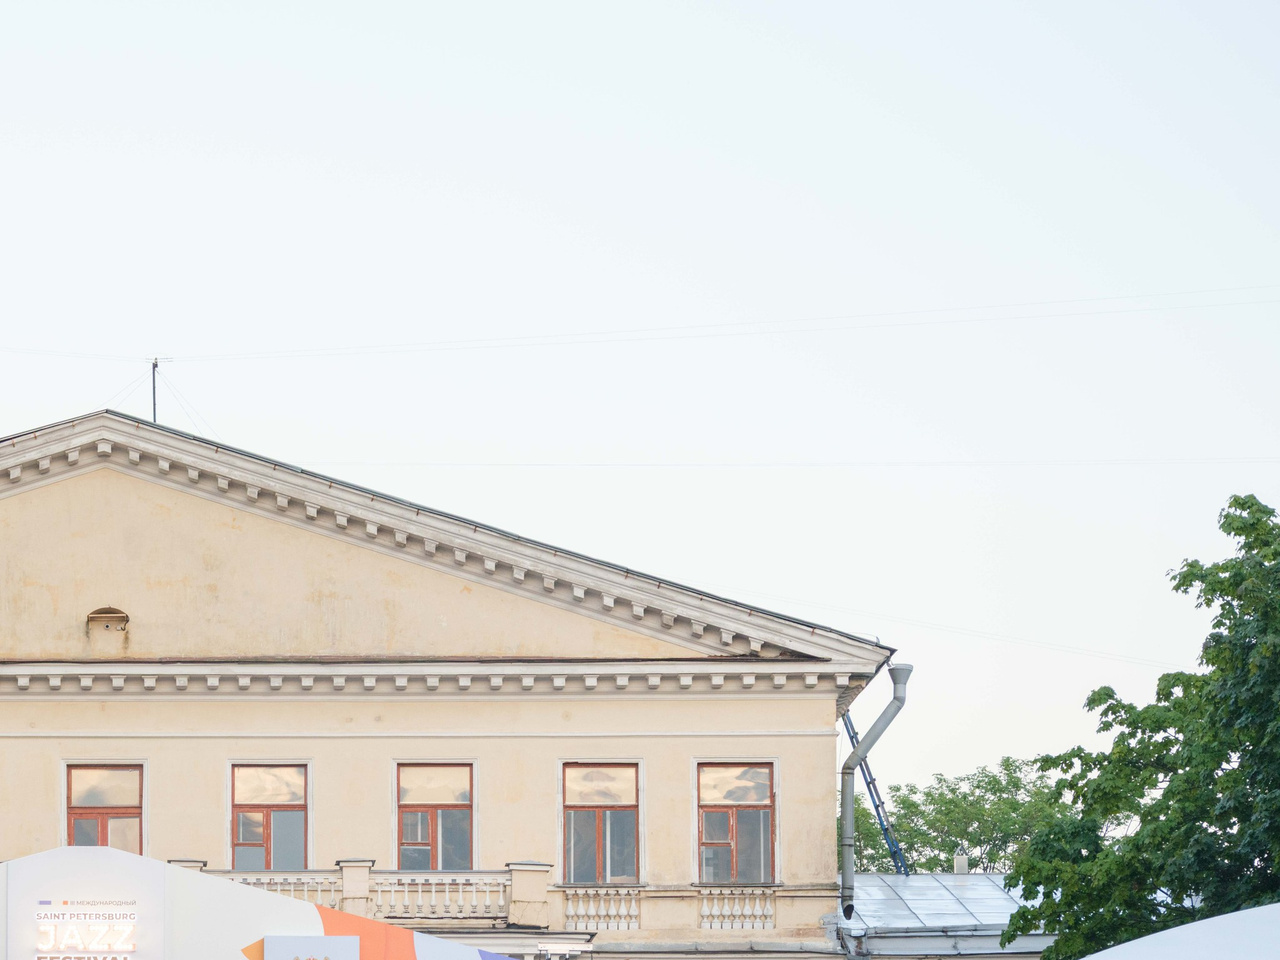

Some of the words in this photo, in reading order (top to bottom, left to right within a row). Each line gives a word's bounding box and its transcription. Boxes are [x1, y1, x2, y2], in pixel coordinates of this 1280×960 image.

[36, 913, 67, 921] SAINT
[69, 913, 136, 921] PETERSBURG
[36, 924, 136, 952] JAZZ
